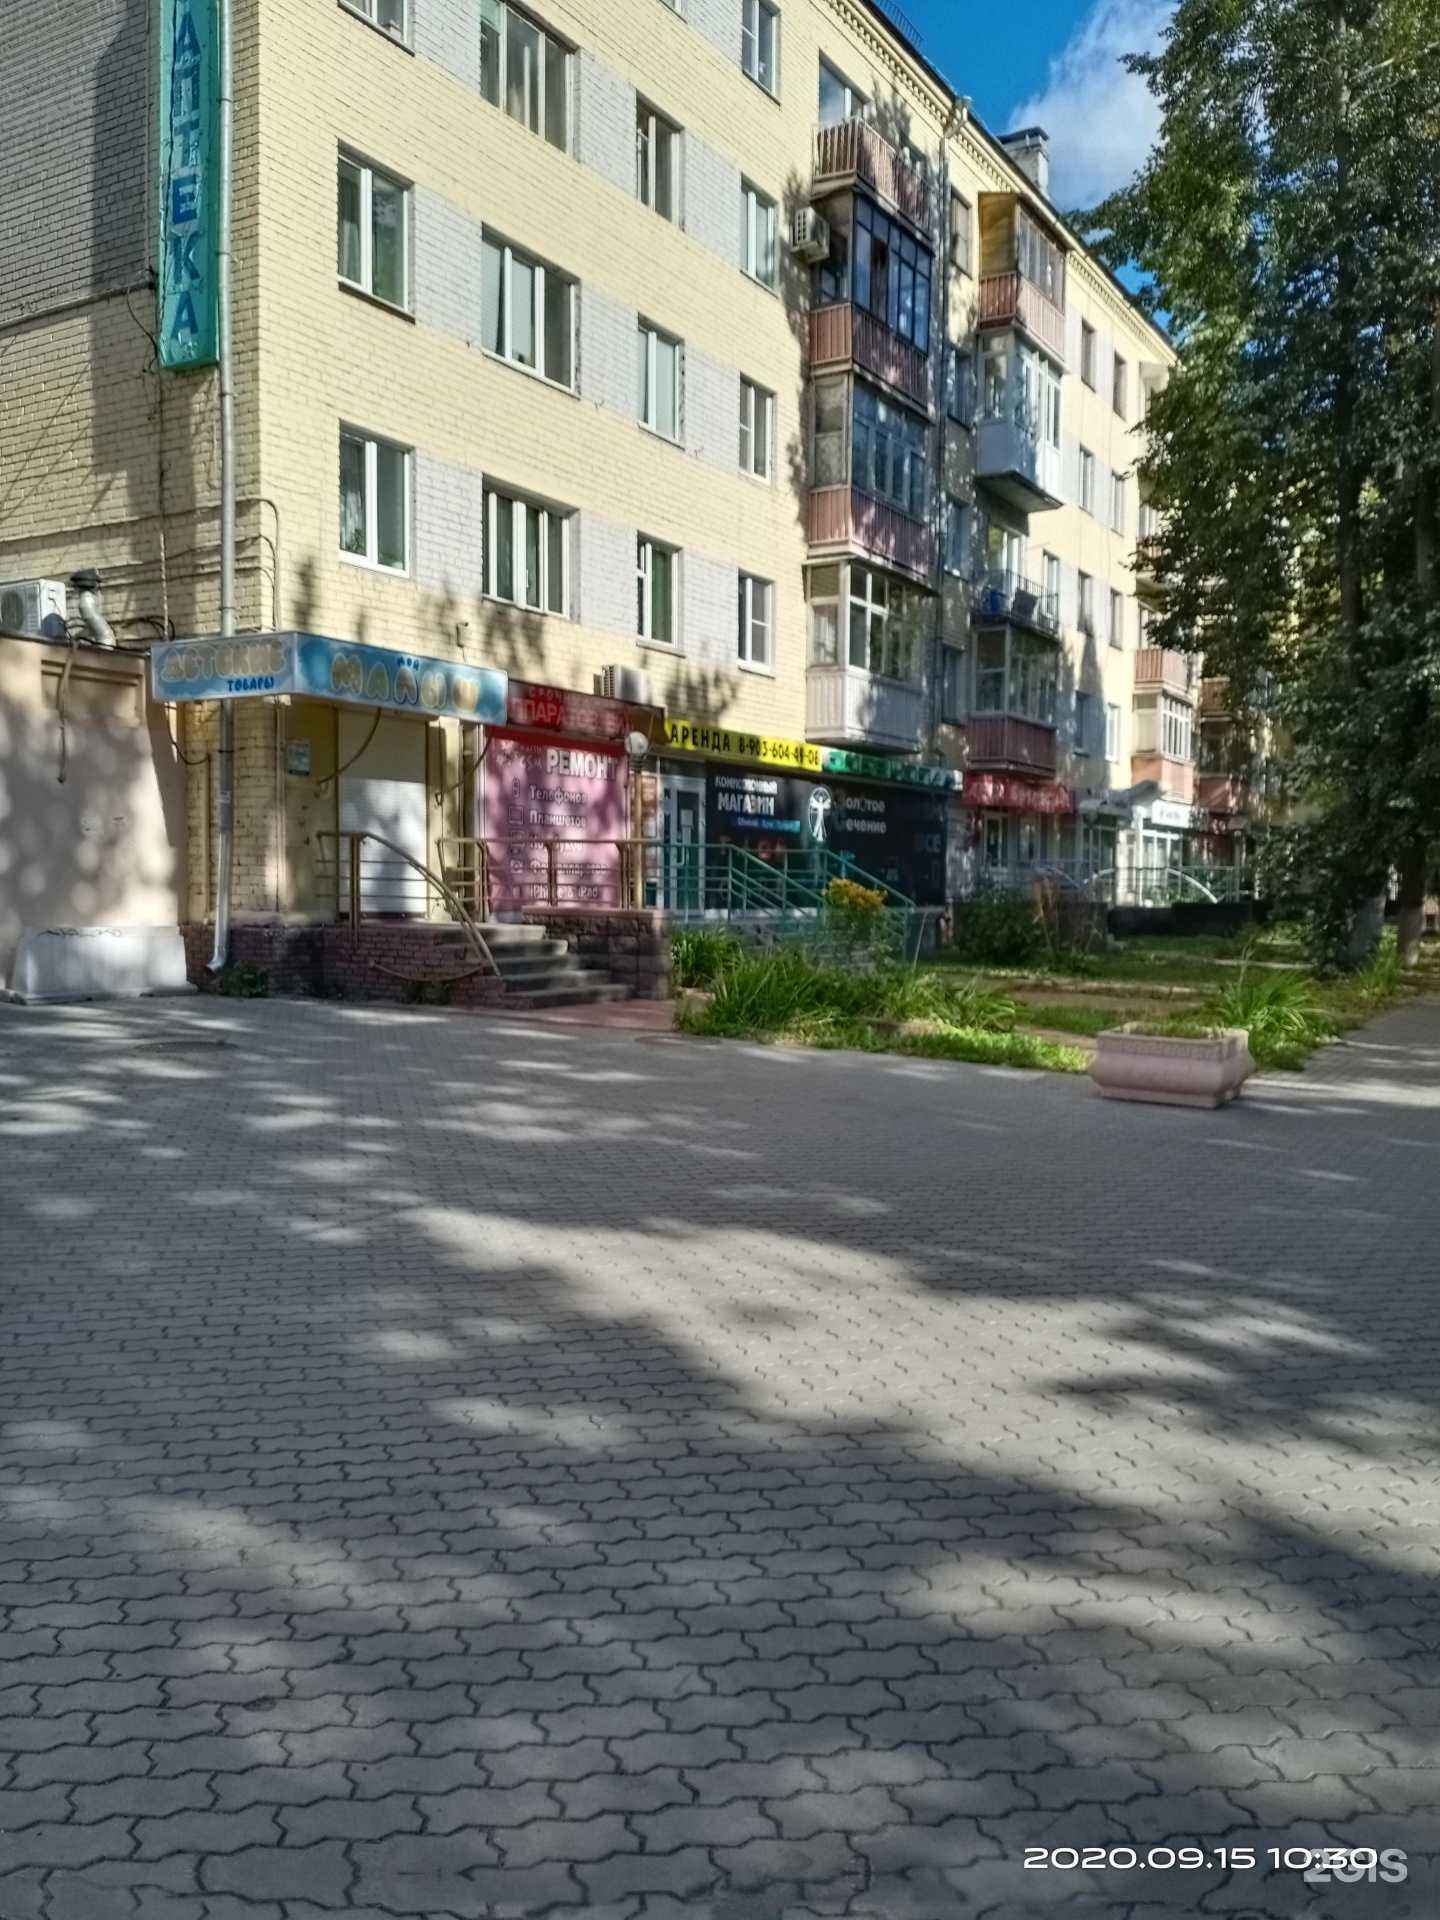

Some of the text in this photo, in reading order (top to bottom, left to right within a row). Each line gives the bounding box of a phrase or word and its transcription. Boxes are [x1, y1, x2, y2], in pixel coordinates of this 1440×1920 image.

[171, 12, 202, 338] АПТЕКА
[227, 676, 275, 692] ТОВАРЫ
[671, 722, 731, 753] АРЕНДА
[546, 748, 619, 780] РЕМОНТ
[717, 792, 776, 816] МАГАЗИН
